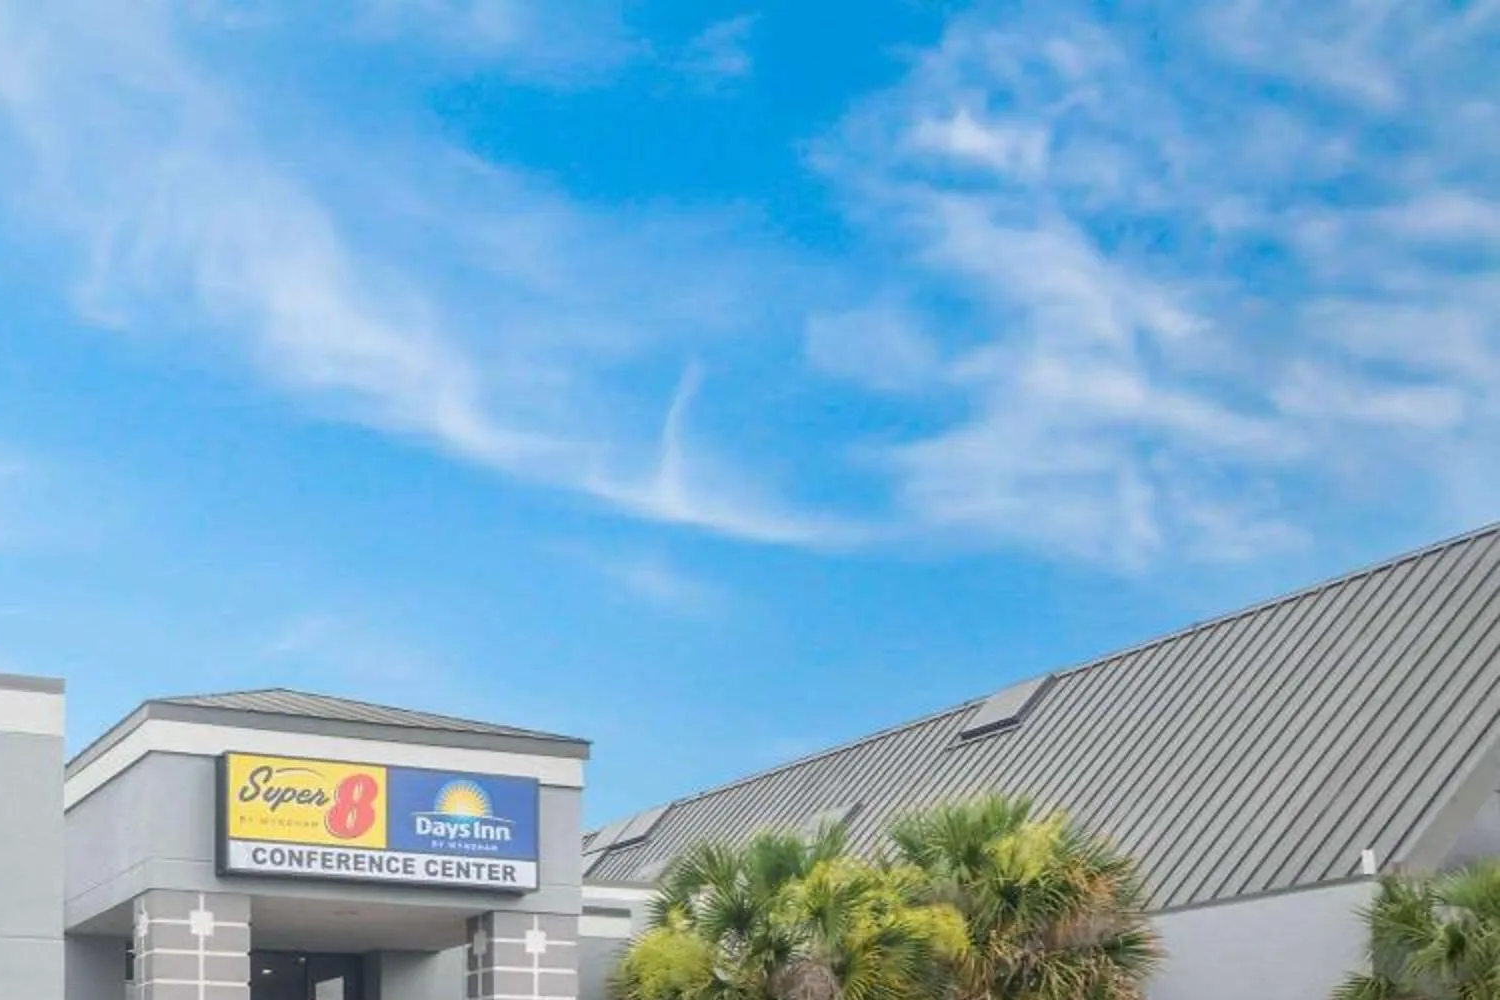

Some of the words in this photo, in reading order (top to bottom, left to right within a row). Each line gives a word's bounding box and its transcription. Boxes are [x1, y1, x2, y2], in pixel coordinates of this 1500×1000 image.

[239, 765, 330, 812] Super
[324, 774, 378, 839] 8
[415, 815, 471, 840] Days
[473, 821, 511, 841] Inn
[251, 847, 416, 876] CONFERENCE
[424, 859, 517, 883] CENTER
